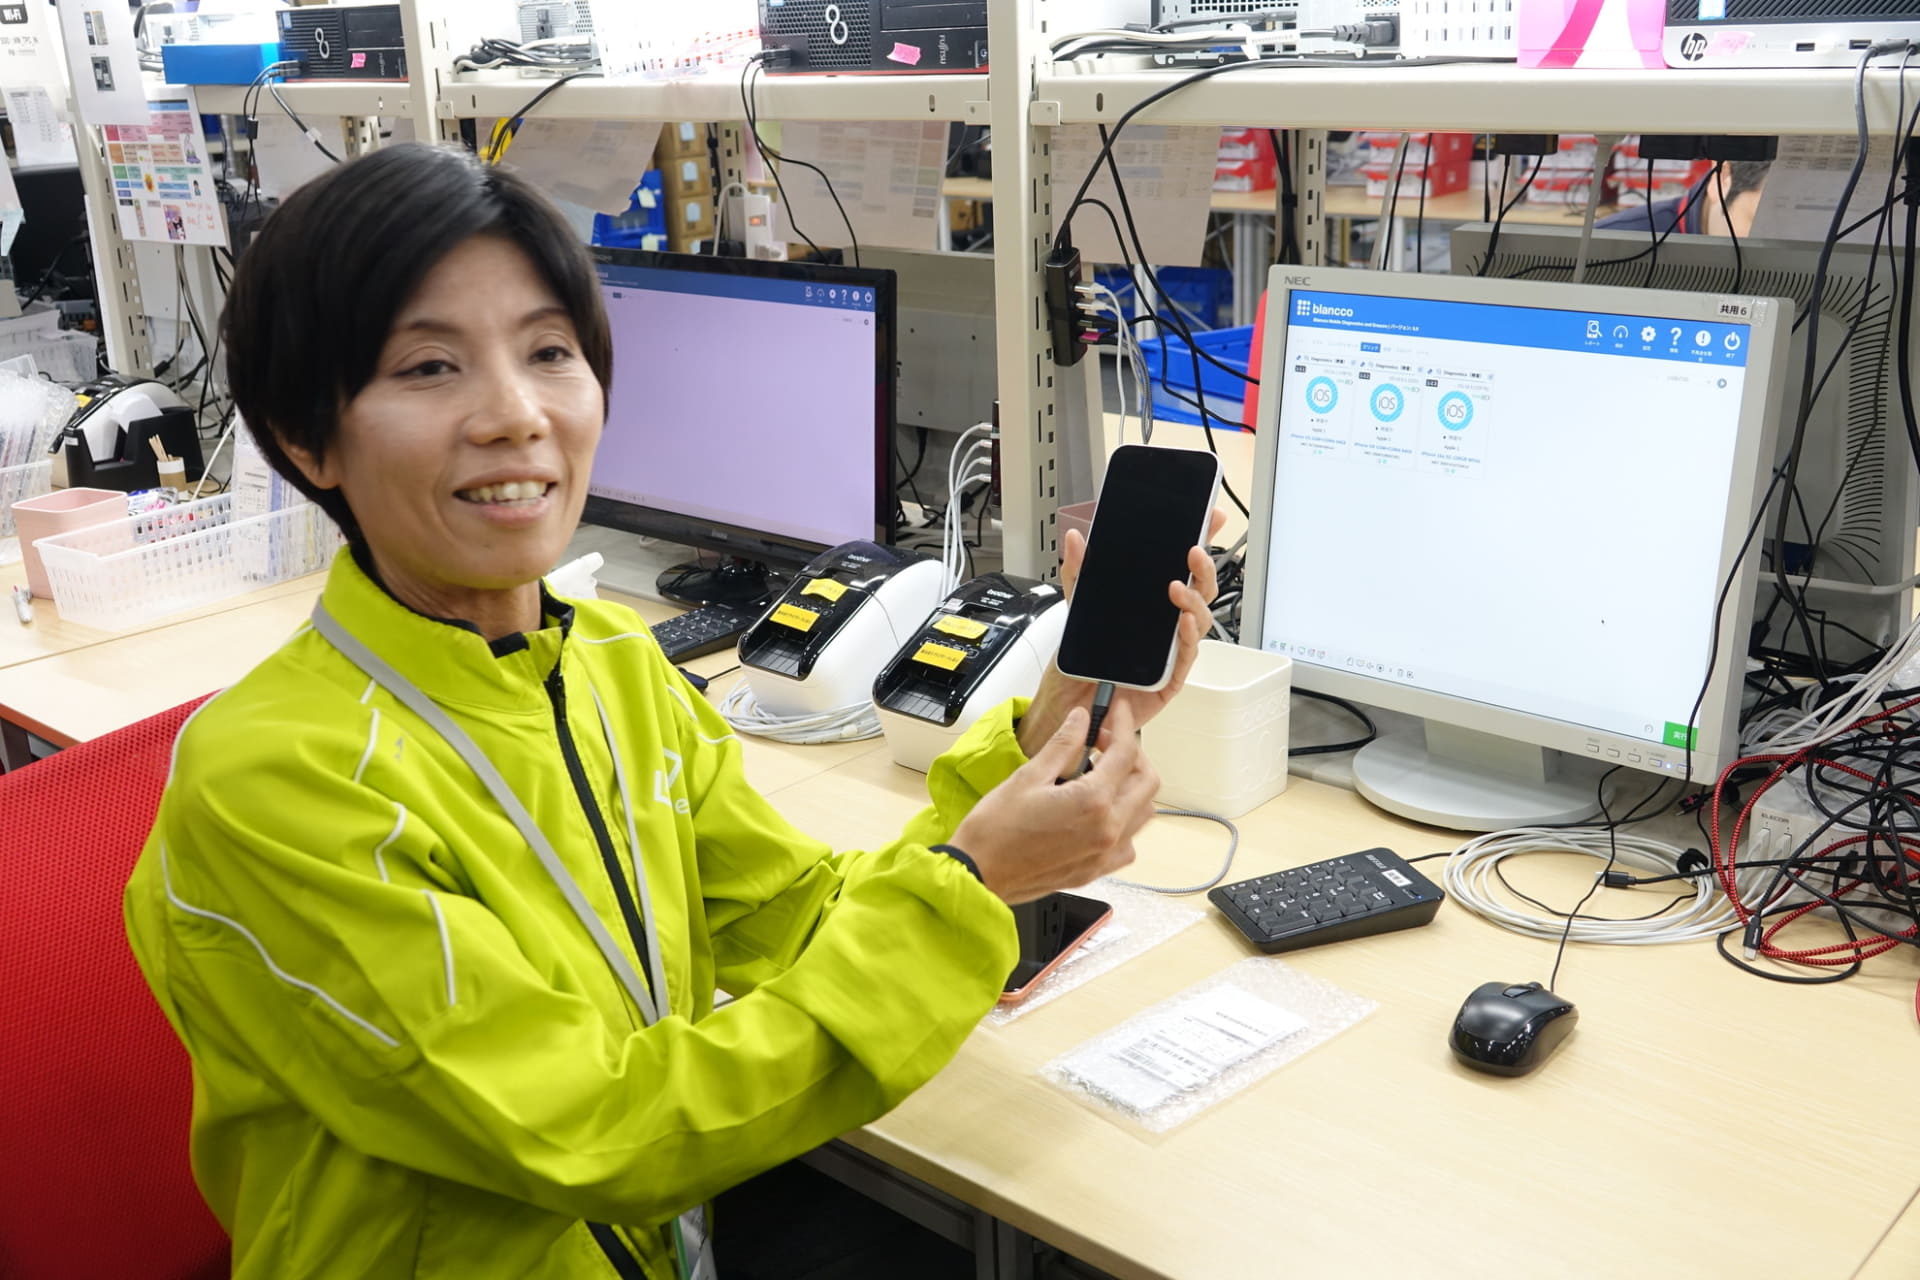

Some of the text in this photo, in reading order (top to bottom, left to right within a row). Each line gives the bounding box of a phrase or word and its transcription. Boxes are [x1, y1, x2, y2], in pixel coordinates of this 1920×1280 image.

[938, 34, 949, 65] FUJITSU
[1682, 33, 1707, 61] hp
[1284, 276, 1311, 286] NEC
[1313, 304, 1353, 317] blancco
[1720, 304, 1748, 316] 共用 6
[1313, 388, 1330, 402] iOS
[1378, 396, 1395, 410] iOS
[1446, 404, 1464, 418] iOS
[986, 588, 1014, 599] brother
